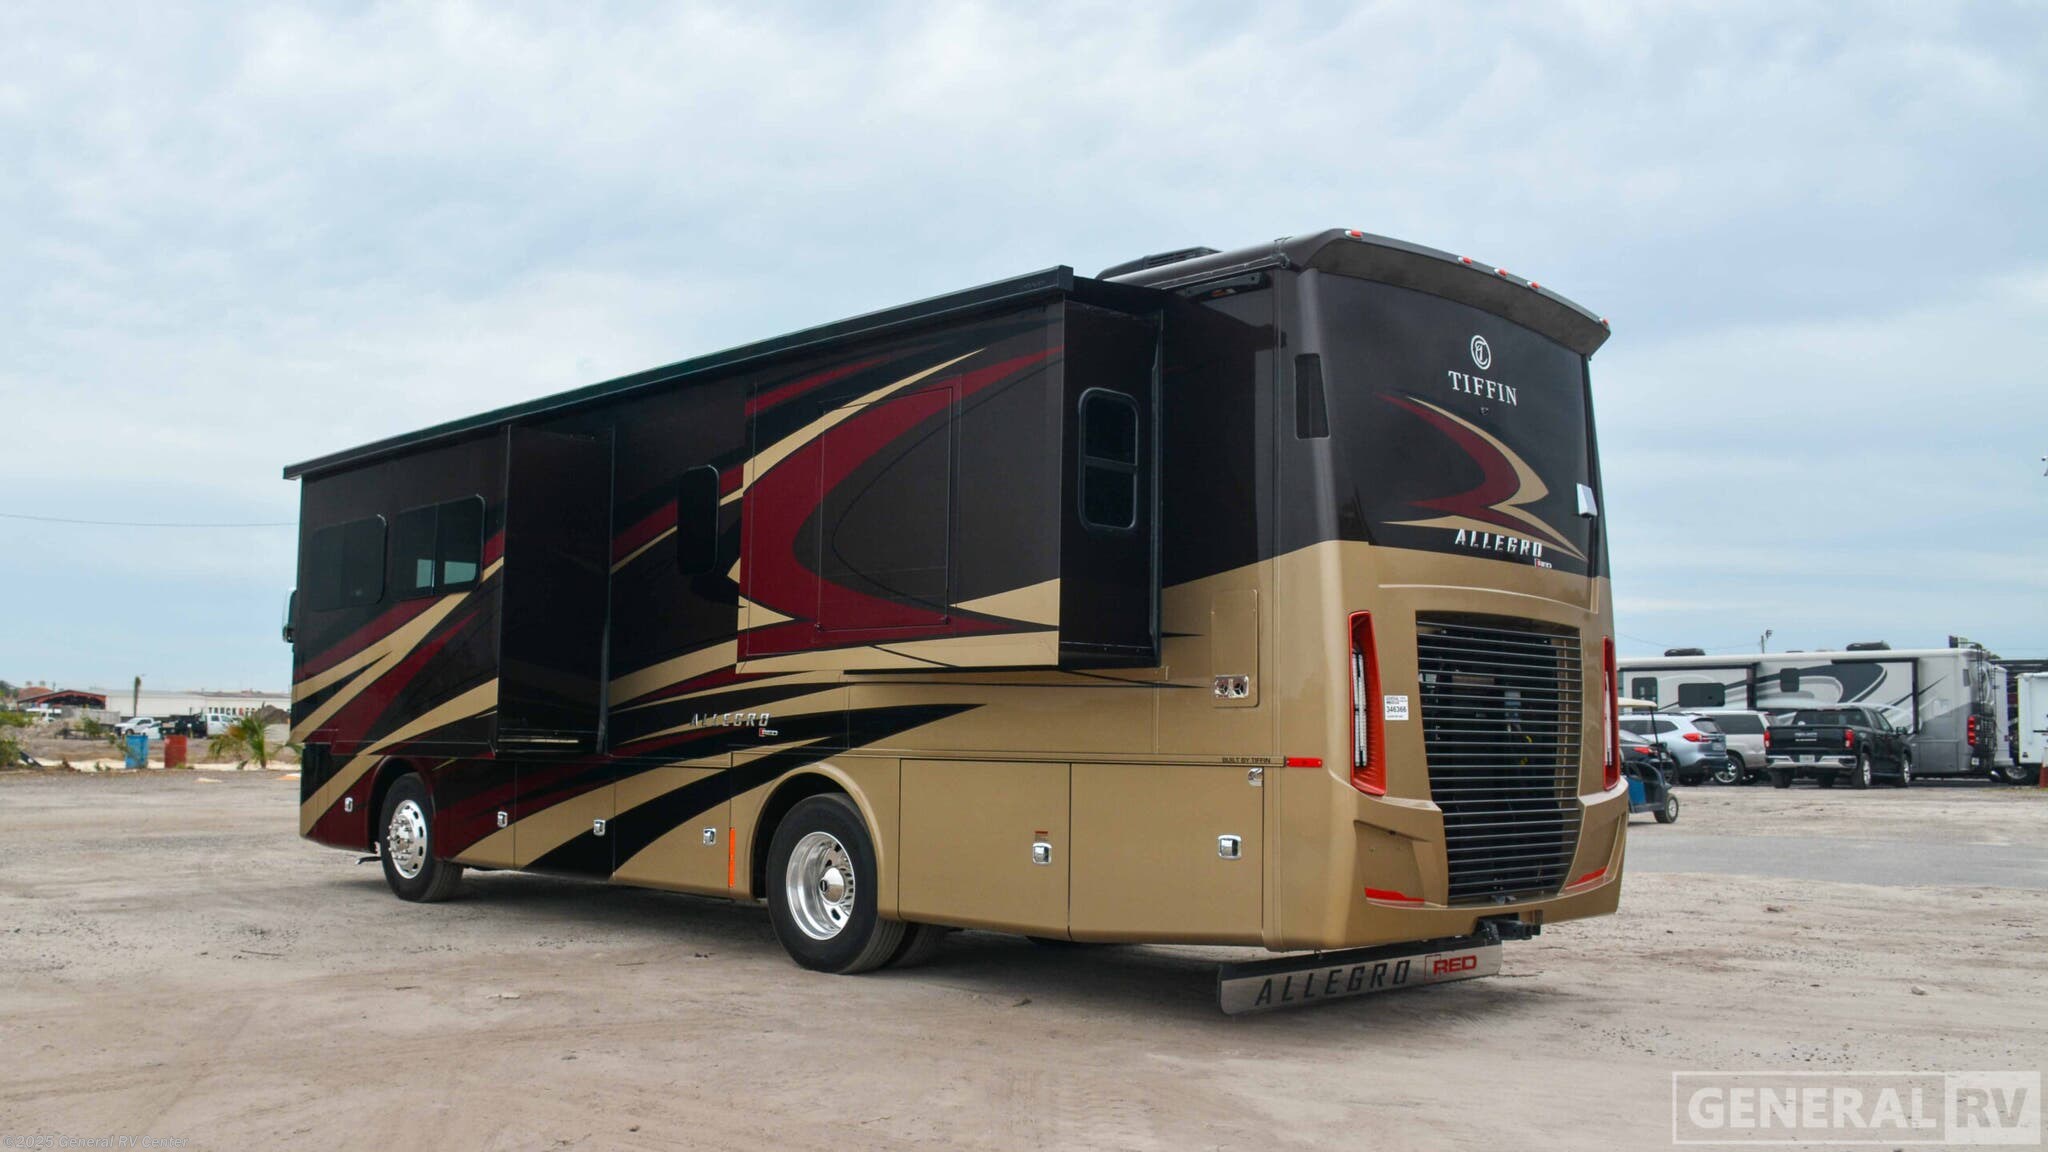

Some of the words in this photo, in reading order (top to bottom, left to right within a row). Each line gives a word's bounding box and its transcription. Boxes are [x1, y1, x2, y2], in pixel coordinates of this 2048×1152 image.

[1448, 370, 1518, 407] TIFFIN
[1454, 528, 1543, 558] ALLEGRO
[687, 712, 770, 728] ALLEGRO
[1255, 959, 1411, 1006] ALLEGRO
[1432, 955, 1477, 975] RED
